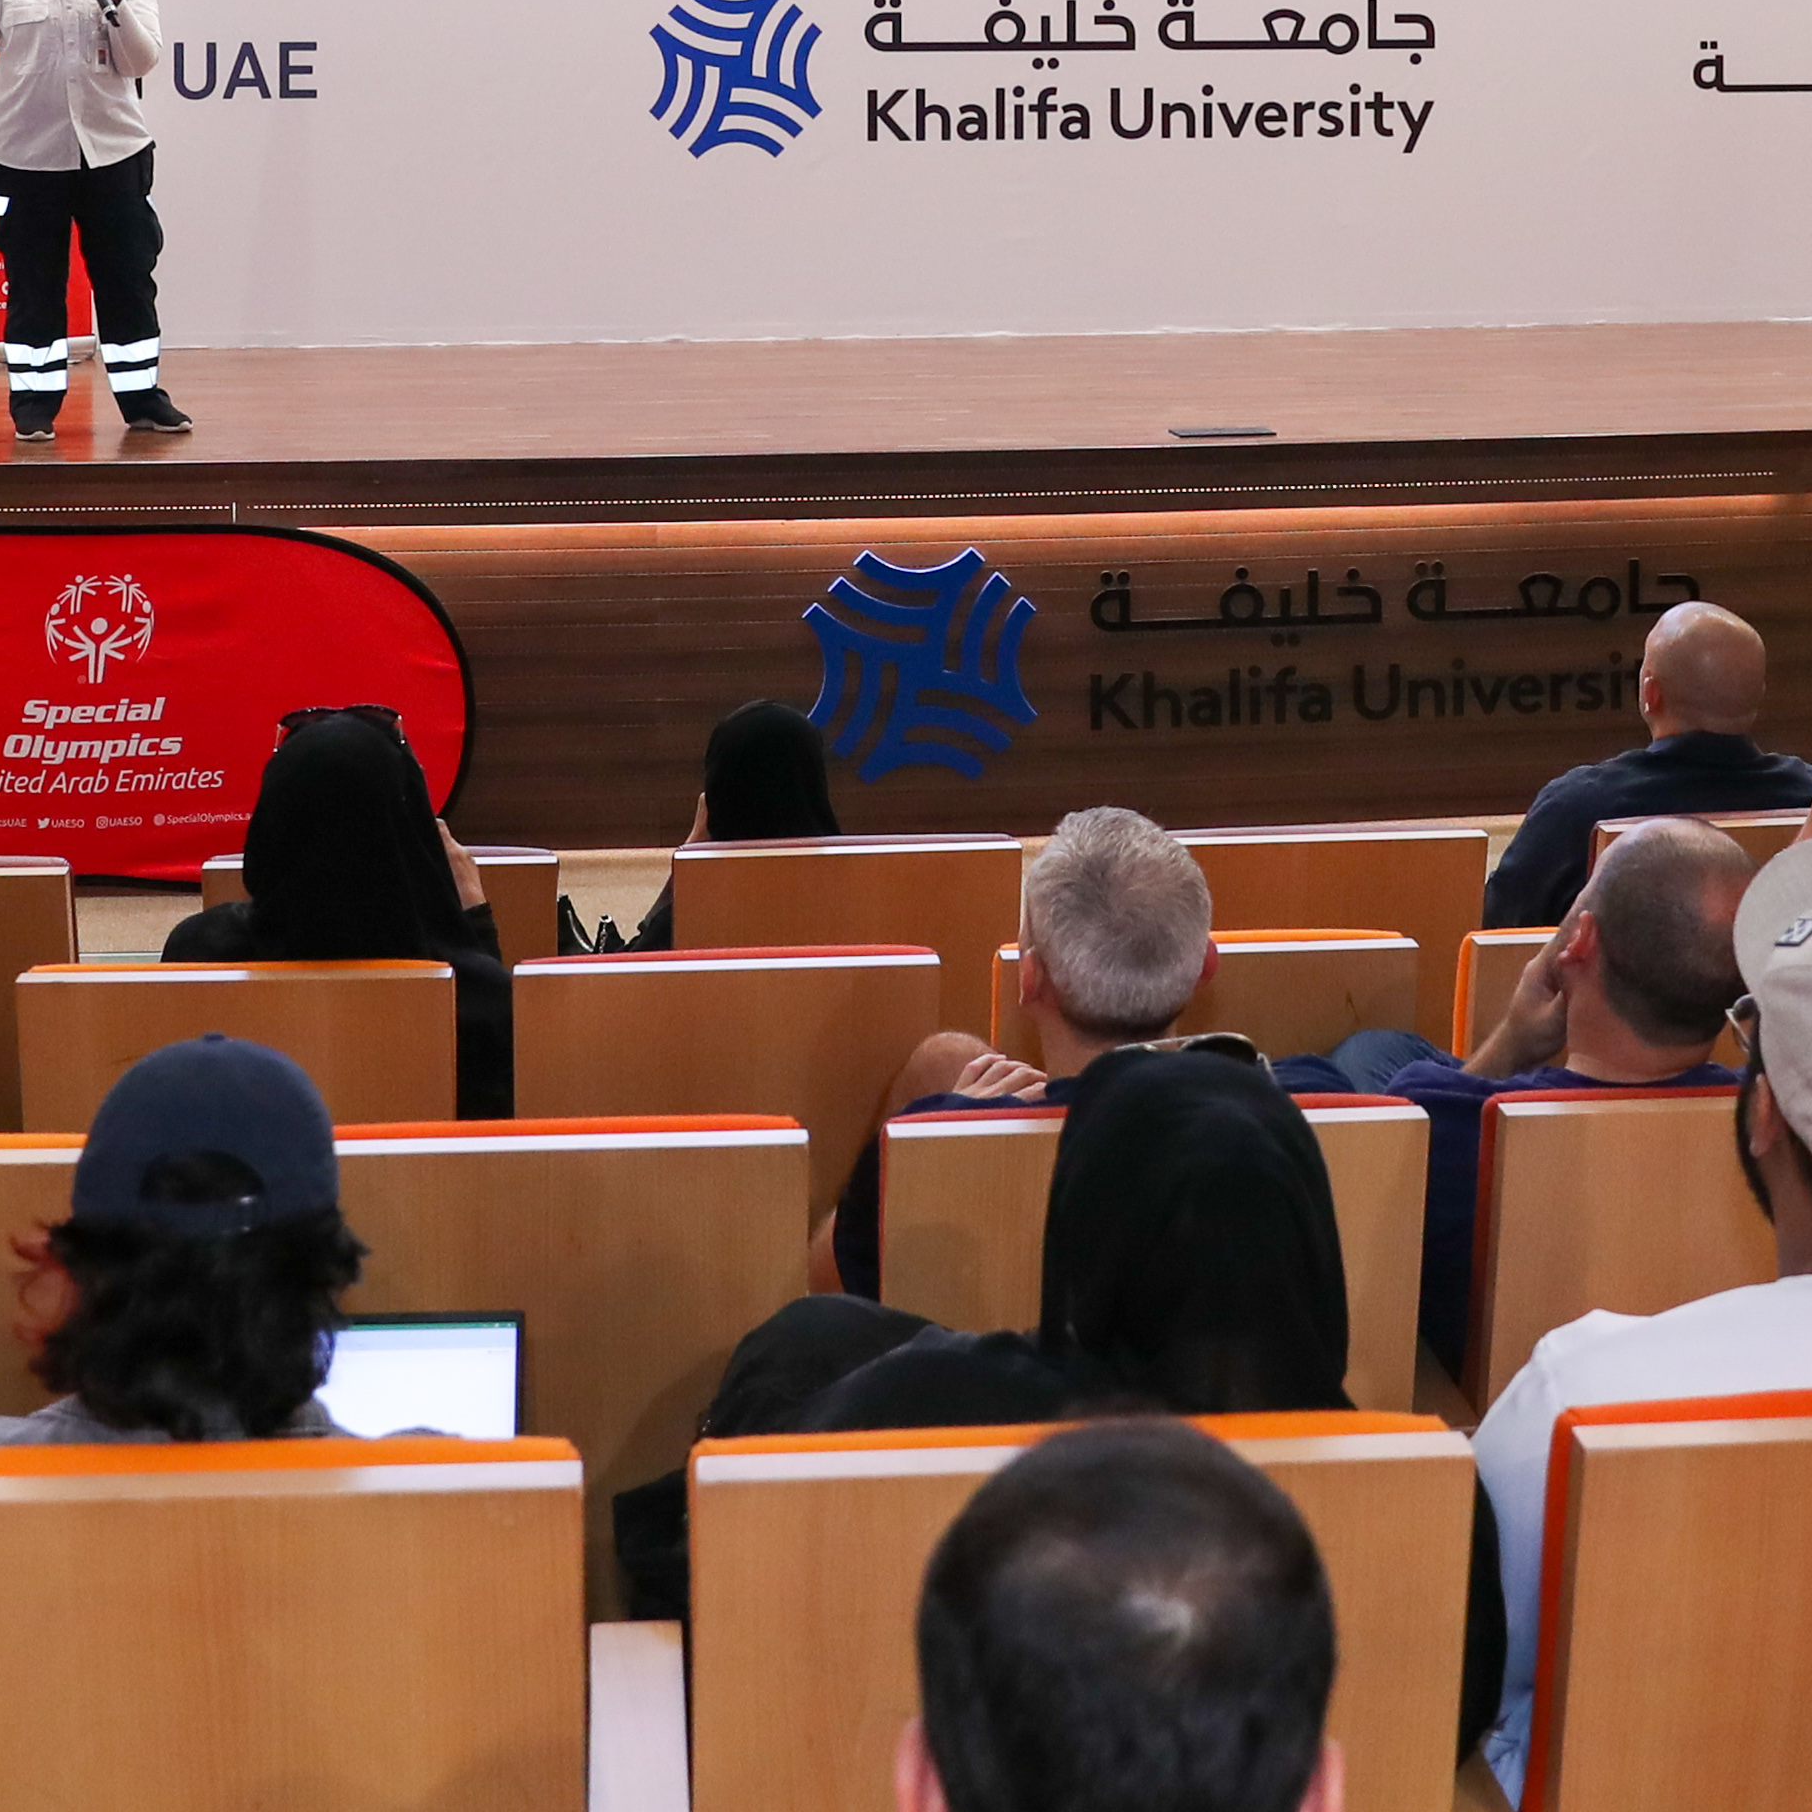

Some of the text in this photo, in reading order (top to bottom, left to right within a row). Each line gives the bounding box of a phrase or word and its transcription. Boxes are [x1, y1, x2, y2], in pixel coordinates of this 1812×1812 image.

[173, 42, 319, 100] UAE
[866, 84, 1435, 155] Khalifa University
[1090, 566, 1382, 649] خليفة
[22, 696, 166, 729] Special
[1088, 665, 1333, 733] Khalifa
[2, 733, 183, 765] Olympics
[48, 767, 108, 795] Arab
[114, 765, 225, 793] Emirates
[51, 818, 86, 829] UAESO
[109, 816, 143, 828] UAESO
